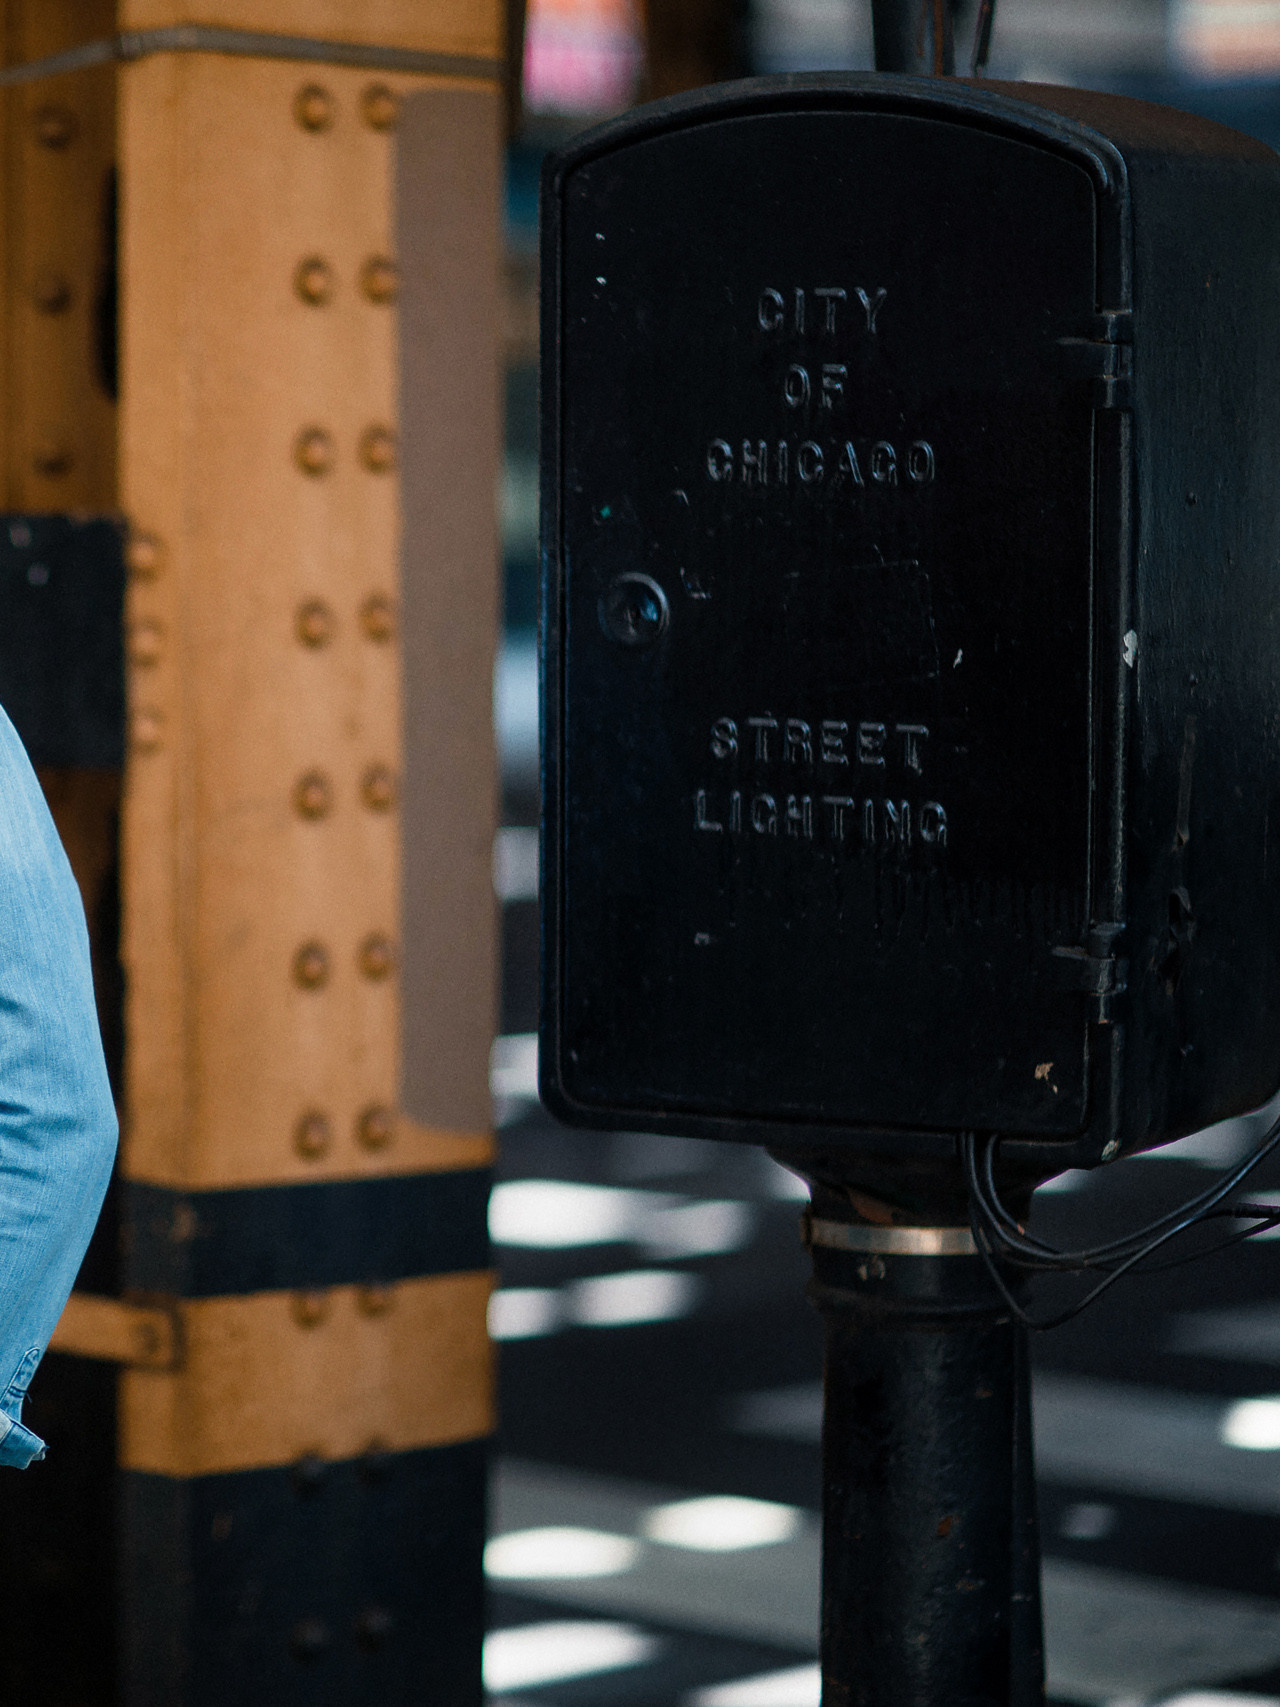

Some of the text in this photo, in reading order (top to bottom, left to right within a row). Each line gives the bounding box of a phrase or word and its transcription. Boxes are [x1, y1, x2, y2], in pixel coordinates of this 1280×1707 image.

[757, 286, 888, 335] CITY
[784, 362, 849, 409] OF
[706, 437, 936, 487] CHICAGO
[710, 715, 930, 773] STREET
[694, 788, 949, 847] LIGHTING
